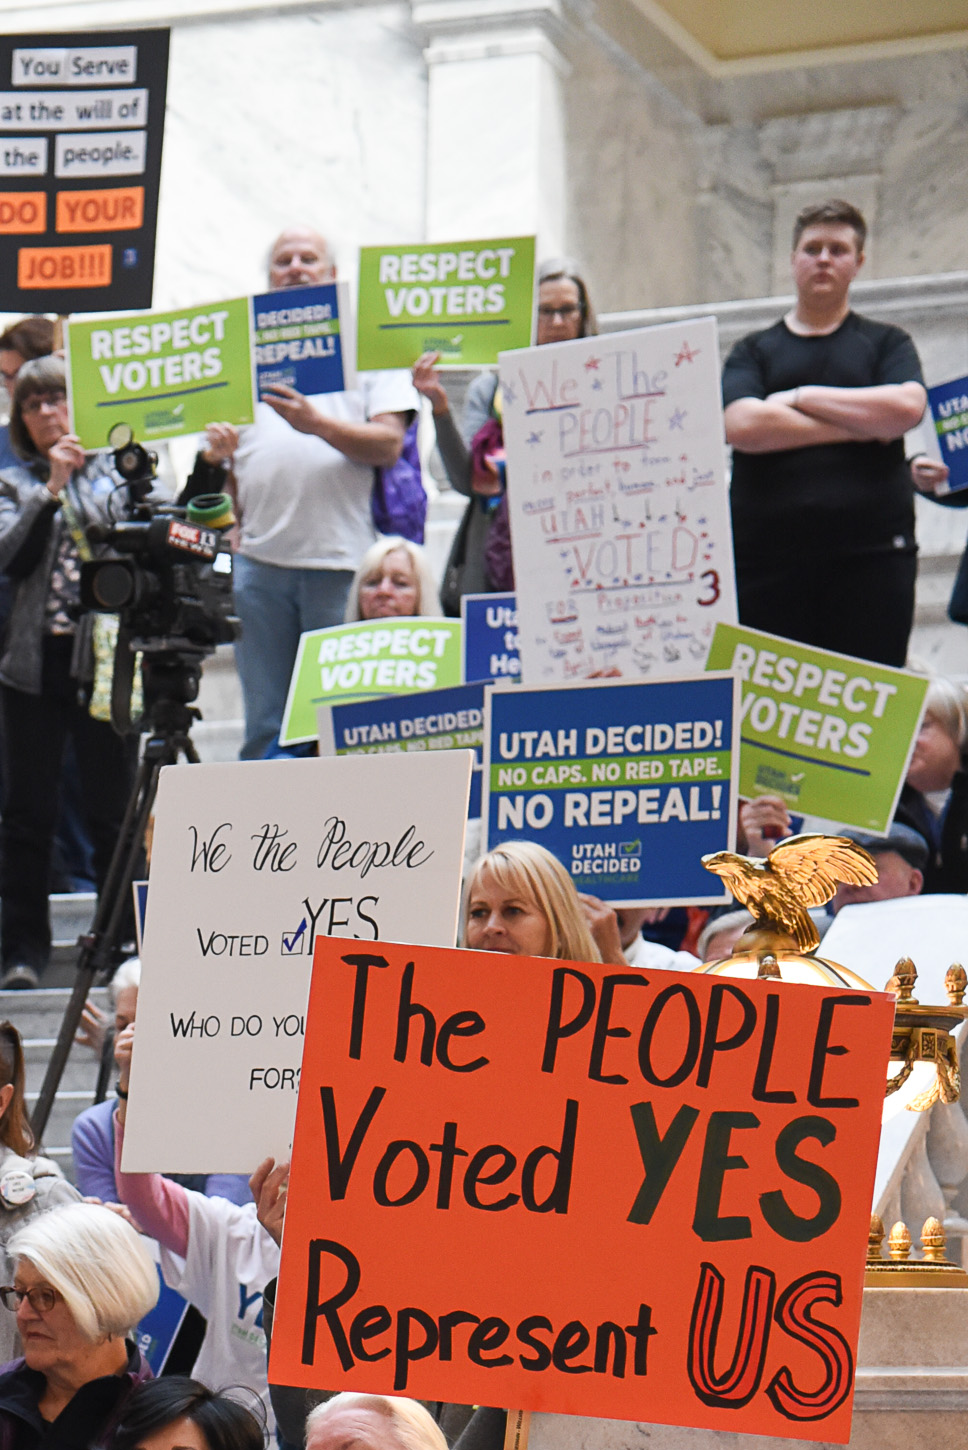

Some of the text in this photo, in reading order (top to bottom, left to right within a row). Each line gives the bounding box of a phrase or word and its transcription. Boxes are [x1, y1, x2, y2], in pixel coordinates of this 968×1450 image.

[20, 56, 129, 76] You Serve
[1, 97, 139, 120] at the will of
[4, 148, 39, 166] the
[65, 197, 136, 222] YOUR
[28, 253, 104, 280] JOB!!!
[379, 248, 515, 283] RESPECT
[385, 284, 506, 317] VOTERS
[91, 311, 229, 360] RESPECT
[100, 347, 222, 394] VOTERS
[518, 359, 580, 409] We
[938, 394, 968, 417] UTA
[558, 400, 658, 451] PEOPLE
[573, 526, 699, 580] VOTED
[697, 569, 721, 606] 3
[318, 629, 452, 665] RESPECT
[320, 659, 437, 691] VOTERS
[732, 643, 897, 718] RESPECT
[344, 709, 483, 746] UTAH DECIDED
[499, 720, 723, 759] UTAH DECIDED!
[498, 757, 722, 786] NO CAPS. NO RED TAPE.
[498, 785, 722, 830] NO REPEAL!
[188, 816, 434, 879] We the People
[572, 843, 616, 859] UTAH
[571, 858, 641, 875] DECIDED
[196, 895, 380, 956] VOTED YES
[170, 1011, 220, 1038] WHO
[231, 1015, 262, 1037] DO
[341, 954, 872, 1108] The PEOPLE
[319, 1085, 841, 1242] Voted YES
[301, 1238, 854, 1422] Represent US
